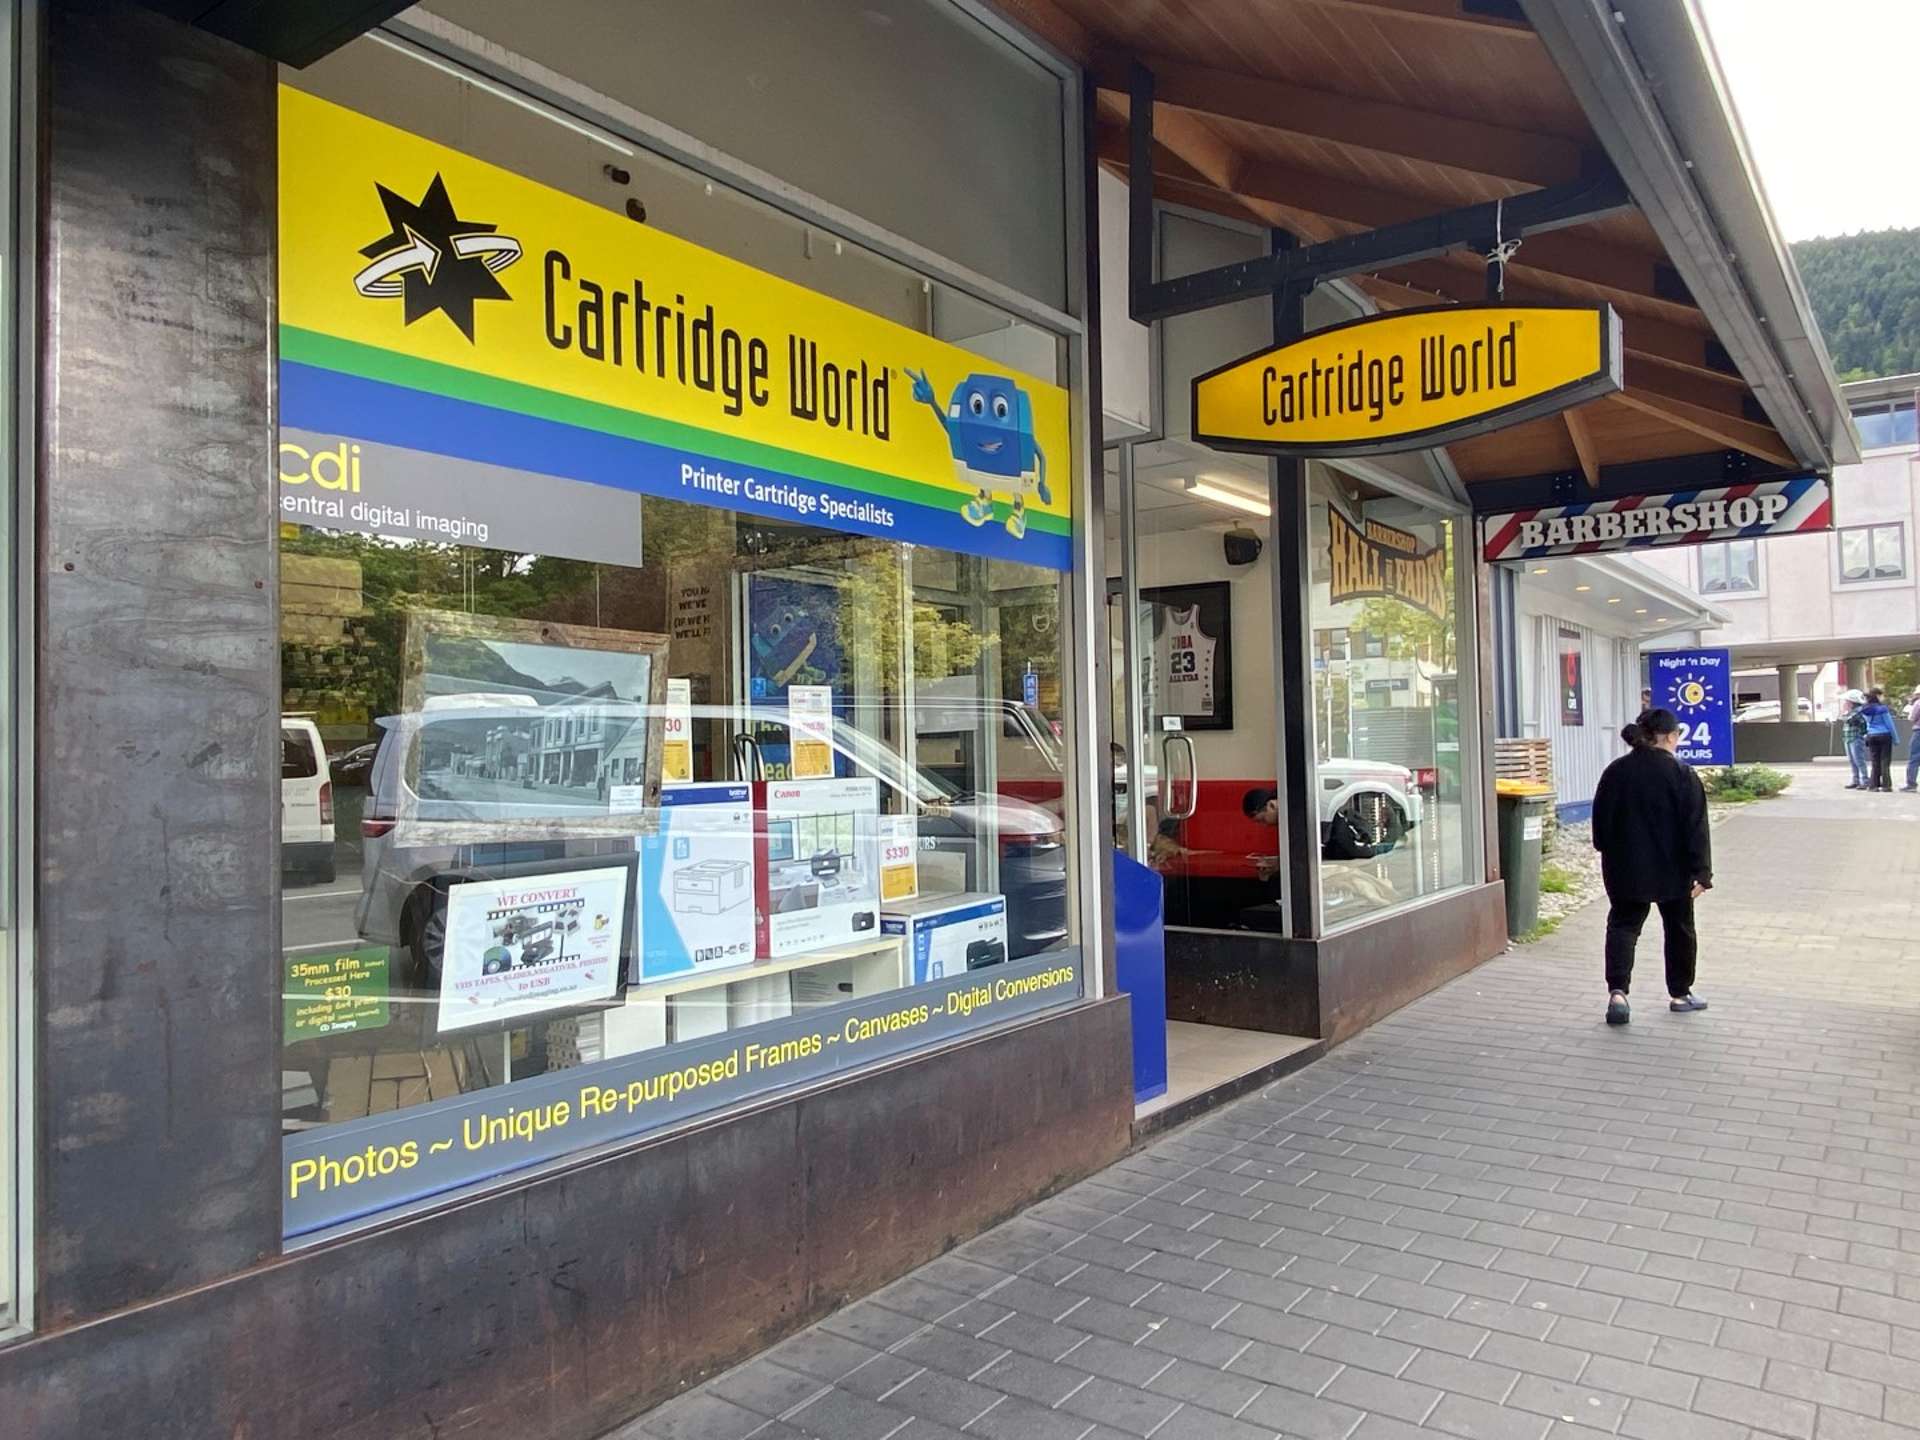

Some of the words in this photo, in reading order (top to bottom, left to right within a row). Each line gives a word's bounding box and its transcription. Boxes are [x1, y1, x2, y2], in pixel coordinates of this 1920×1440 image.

[544, 250, 769, 417] Cartridge
[789, 333, 890, 441] World
[1262, 349, 1404, 426] Cartridge
[1420, 321, 1516, 402] World
[681, 463, 740, 495] Printer
[744, 478, 816, 514] Cartridge
[820, 494, 894, 527] Specialists
[350, 502, 410, 527] digital
[416, 510, 488, 541] imaging
[1520, 493, 1789, 549] BARBERSHOP
[1171, 651, 1195, 674] 23
[1659, 657, 1686, 669] Night
[1700, 656, 1721, 667] Day
[1677, 721, 1712, 746] 24
[774, 789, 801, 799] Canon
[885, 846, 910, 860] $330
[497, 894, 518, 908] WE
[290, 963, 330, 977] 35mm
[335, 958, 360, 972] film
[349, 971, 370, 980] Here
[325, 985, 351, 1001] $30
[290, 1140, 419, 1198] Photos
[463, 1101, 570, 1151] Unique
[580, 1050, 738, 1119] Re-purposed
[746, 1033, 822, 1074] Frames
[845, 1003, 928, 1044] Canvases
[947, 982, 992, 1016] Digital
[995, 964, 1073, 999] Conversions
